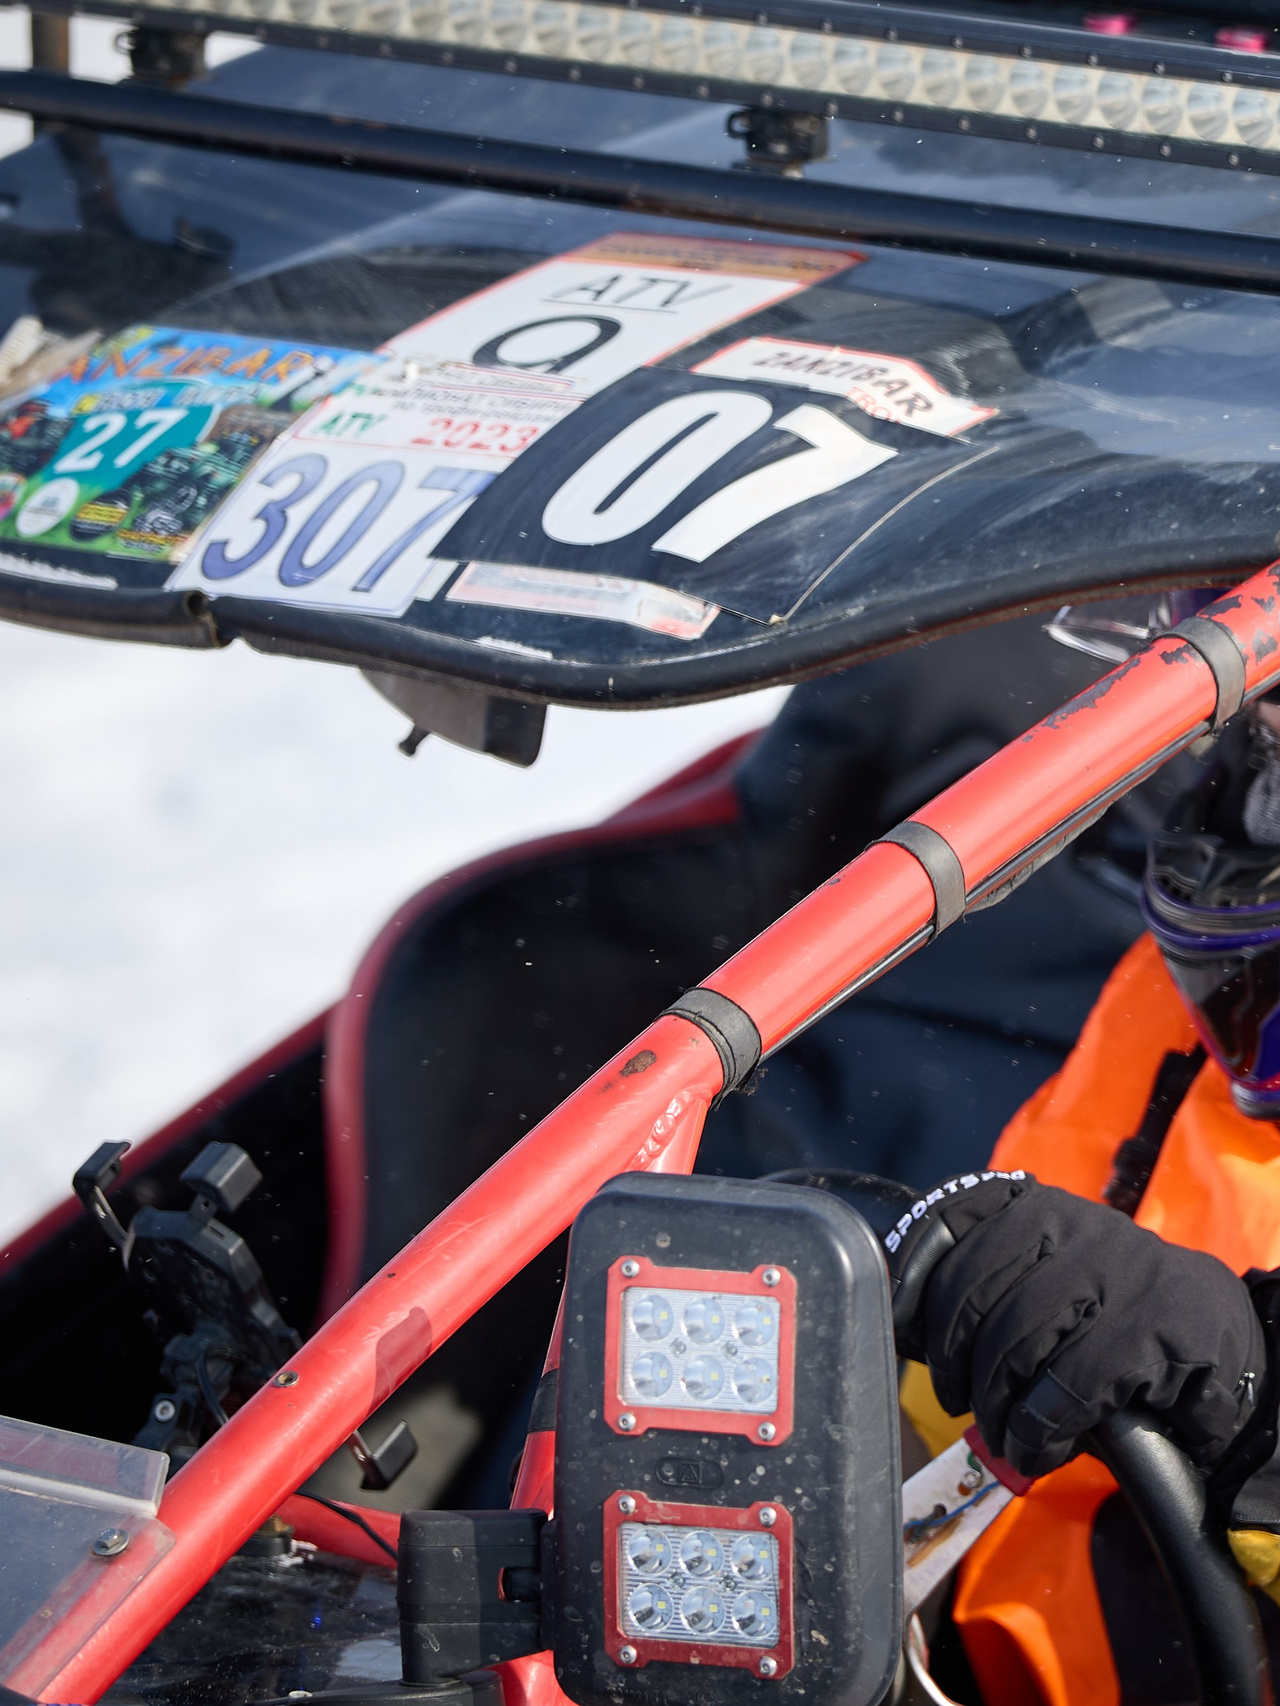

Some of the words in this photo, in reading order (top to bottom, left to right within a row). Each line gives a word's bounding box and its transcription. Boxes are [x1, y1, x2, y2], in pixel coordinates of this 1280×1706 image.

[551, 274, 735, 309] ATV
[46, 344, 314, 384] ANZIBAR
[752, 350, 934, 418] ZANZIBAR
[847, 386, 901, 423] TRO
[53, 410, 190, 474] 27
[410, 417, 540, 453] 2023
[542, 391, 898, 562] 07
[201, 453, 500, 593] 307
